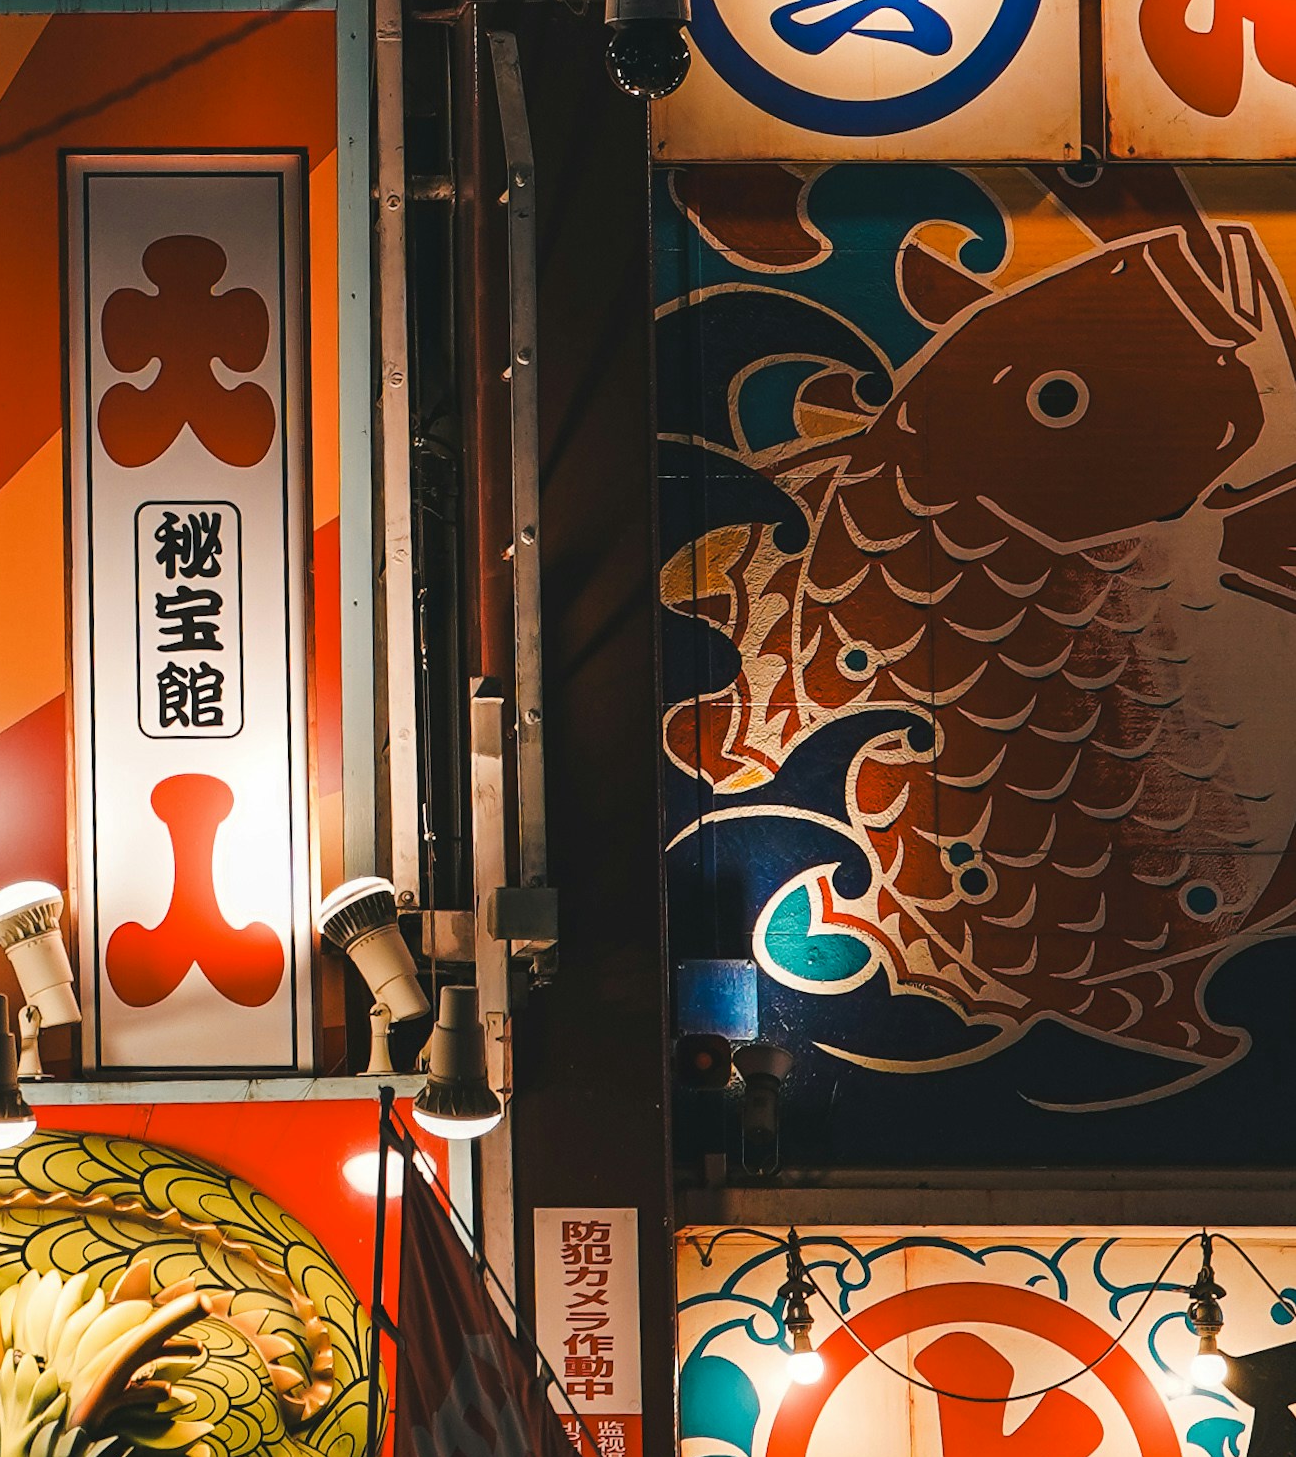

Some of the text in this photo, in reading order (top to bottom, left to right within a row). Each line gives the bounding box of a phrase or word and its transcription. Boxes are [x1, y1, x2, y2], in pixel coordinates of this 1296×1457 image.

[154, 510, 224, 730] 秘宝館
[560, 1219, 615, 1402] 防犯カメラ作動中
